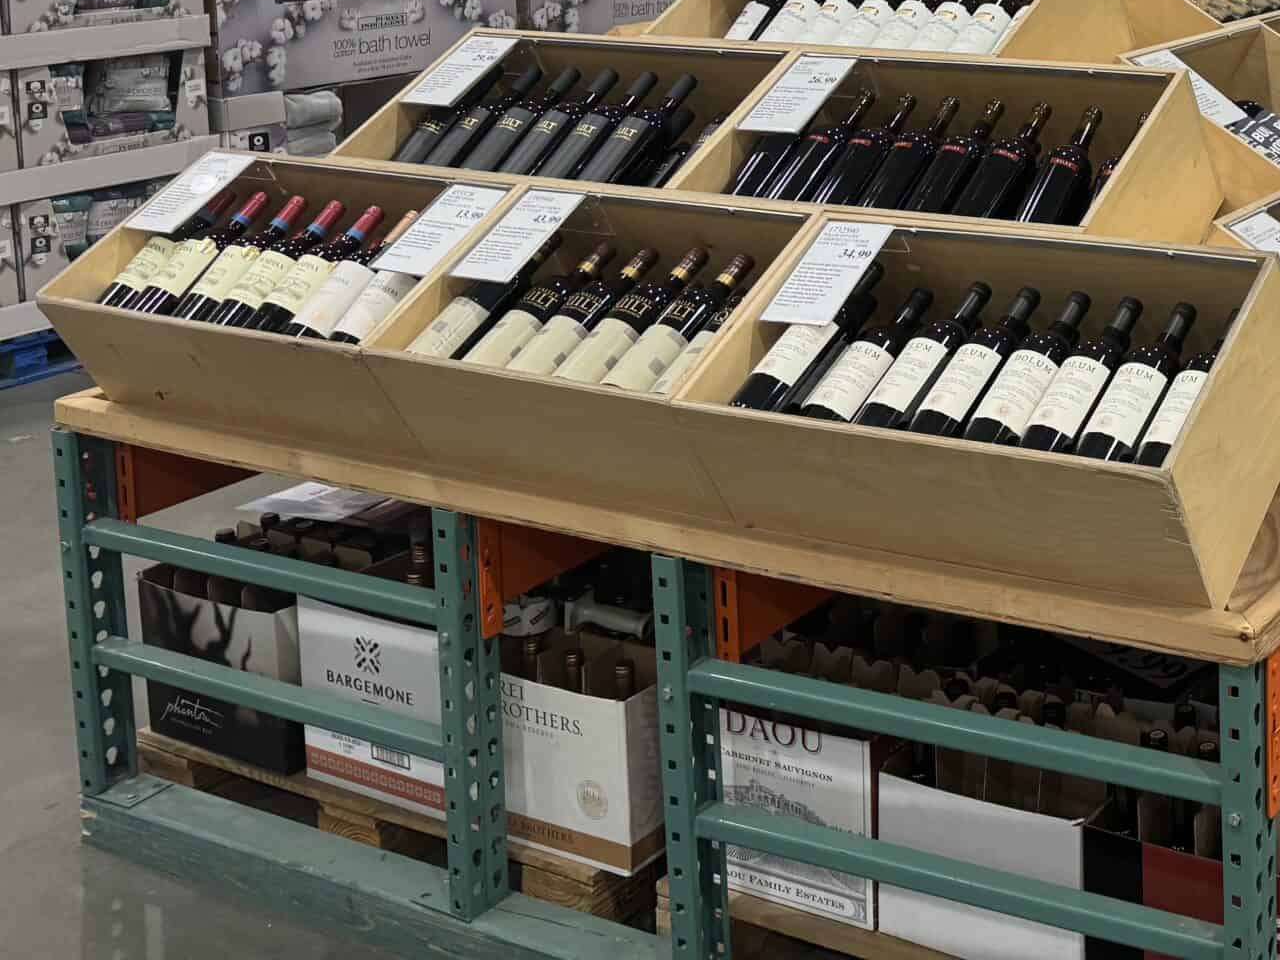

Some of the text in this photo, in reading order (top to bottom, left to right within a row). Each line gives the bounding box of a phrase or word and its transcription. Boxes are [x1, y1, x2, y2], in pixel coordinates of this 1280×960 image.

[359, 27, 431, 55] bath towel
[326, 669, 415, 706] BARGEMONE
[499, 680, 524, 701] REI
[501, 703, 583, 737] ROTHERS.
[726, 710, 823, 753] DAOU
[775, 760, 833, 783] SAUVIGNON
[725, 868, 846, 912] AOU FAMILY ESTATES
